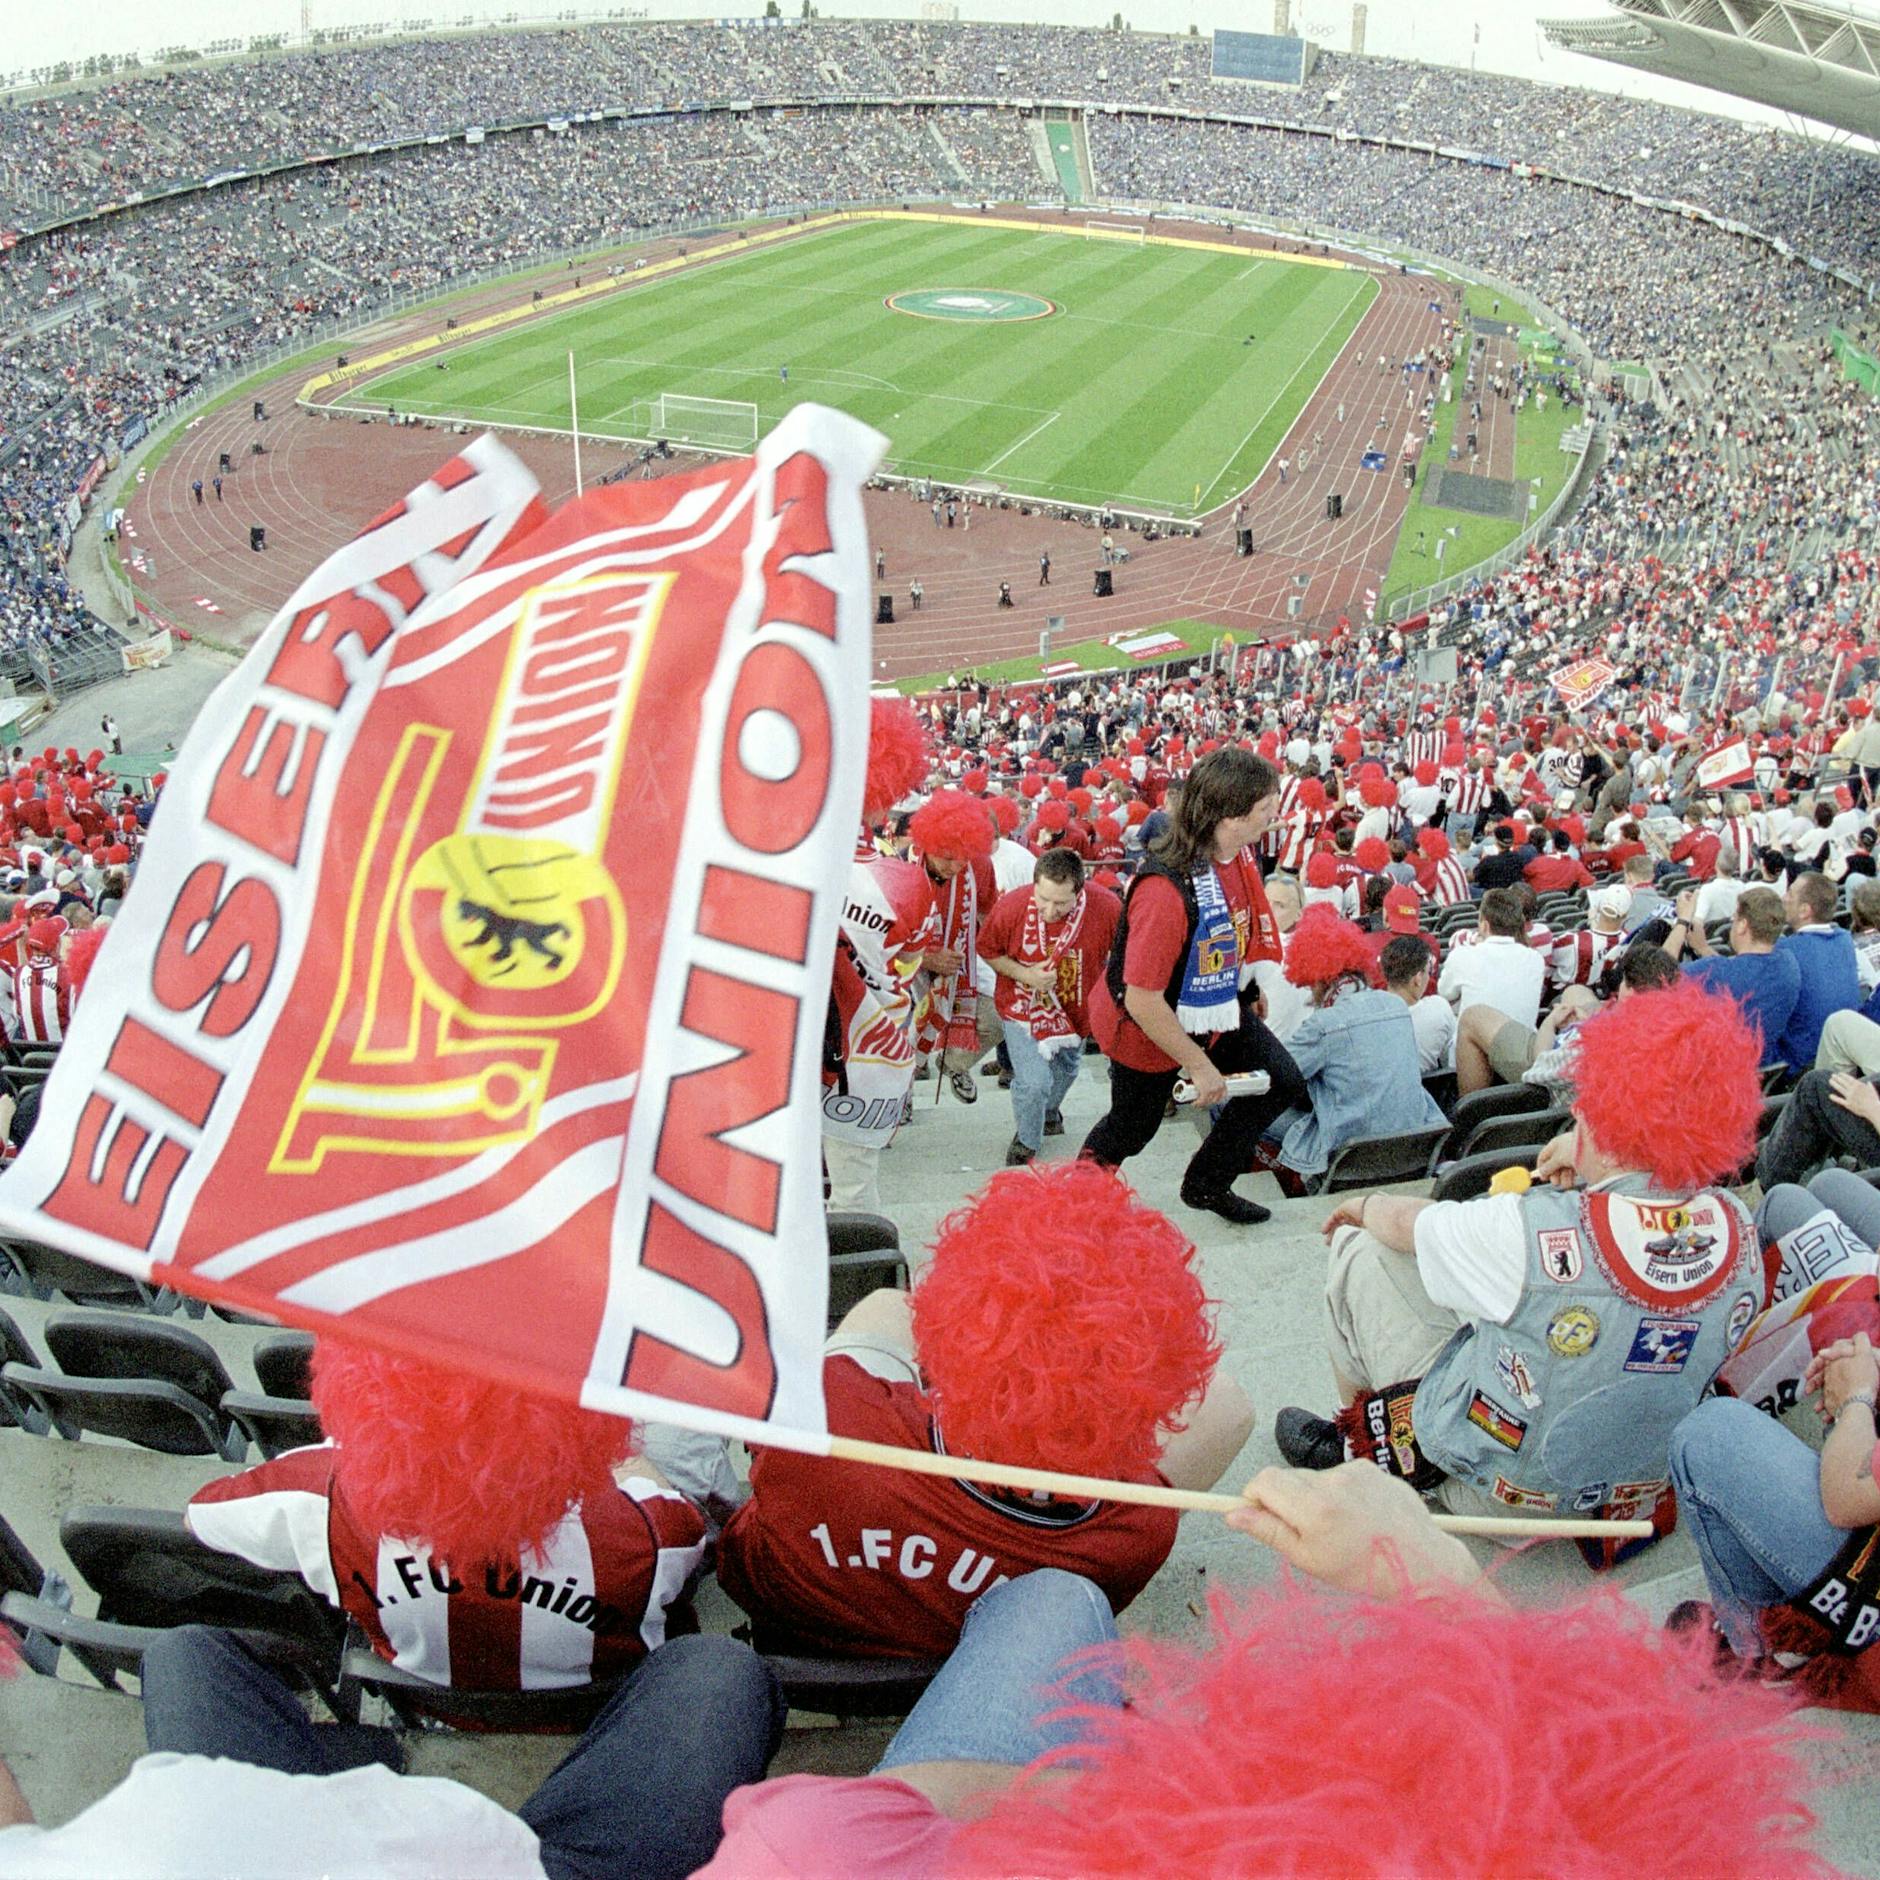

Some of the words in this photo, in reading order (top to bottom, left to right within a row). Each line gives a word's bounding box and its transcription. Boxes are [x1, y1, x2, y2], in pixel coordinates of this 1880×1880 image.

[480, 581, 640, 830] UNION
[620, 451, 838, 1422] UNION
[1192, 970, 1235, 986] BERLIN
[1644, 1262, 1678, 1284] Eisern
[1683, 1259, 1714, 1282] Union
[810, 1523, 937, 1579] 1.FC
